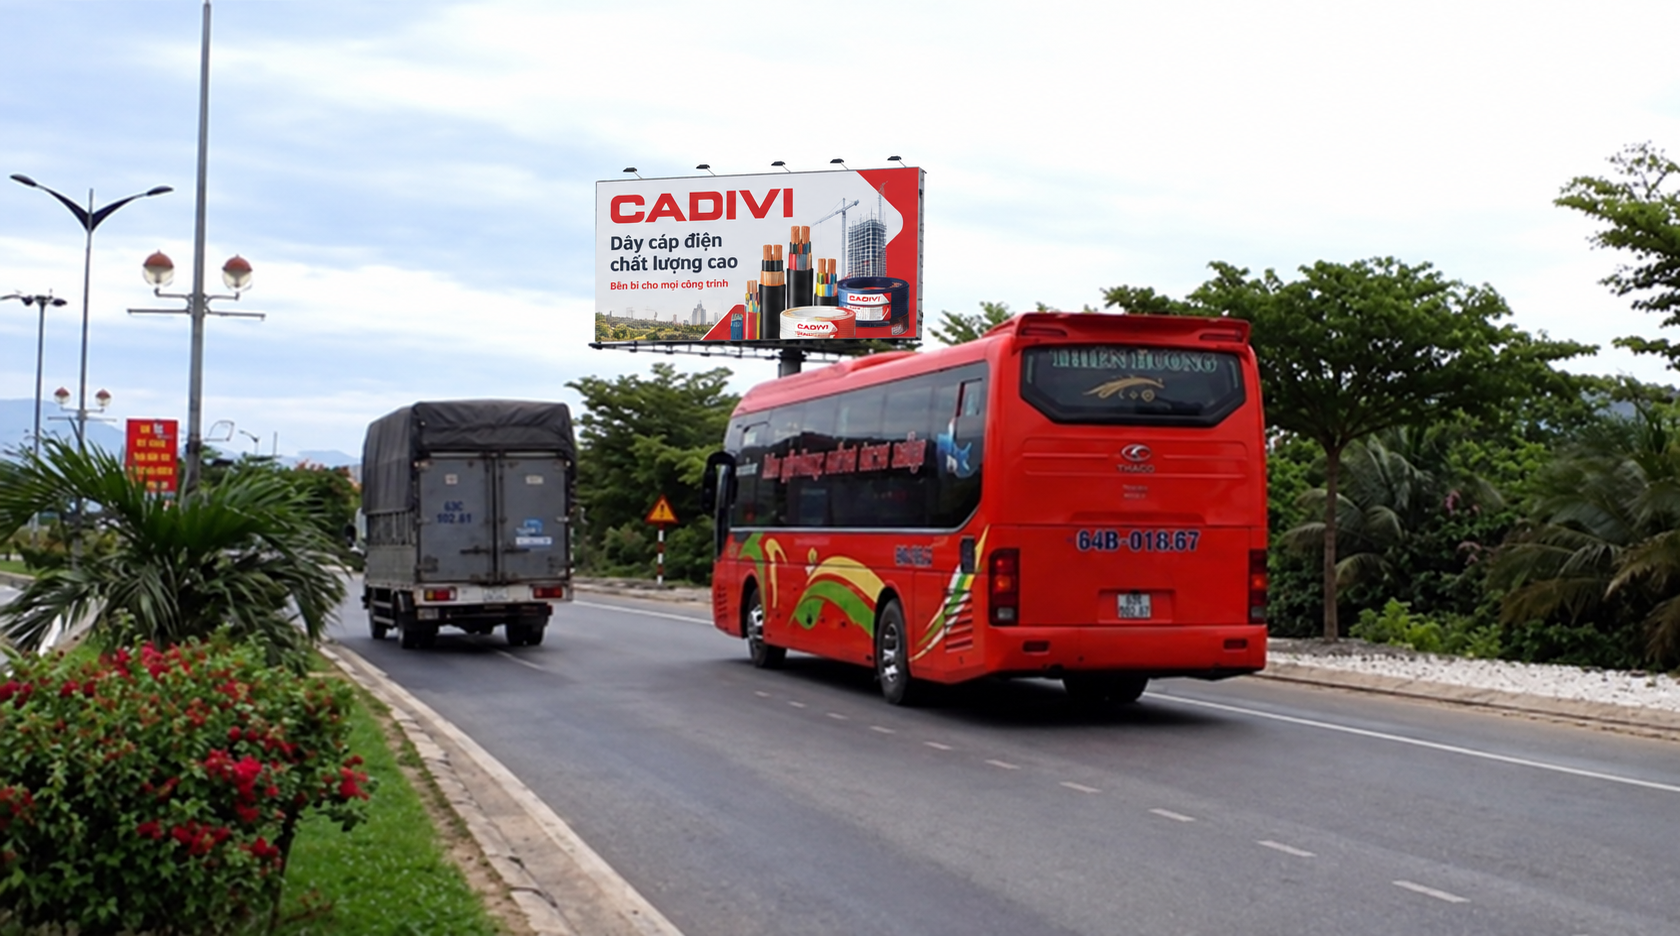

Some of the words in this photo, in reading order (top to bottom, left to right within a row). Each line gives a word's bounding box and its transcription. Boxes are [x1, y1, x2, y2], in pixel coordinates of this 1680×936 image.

[610, 188, 793, 224] CADIVI
[610, 235, 644, 253] Dây
[648, 234, 679, 252] cáp
[684, 232, 722, 251] điện
[610, 255, 648, 271] chất
[653, 256, 702, 274] lượng
[707, 257, 738, 269] cao
[641, 280, 659, 289] cho
[1076, 529, 1200, 552] 64B-018.67
